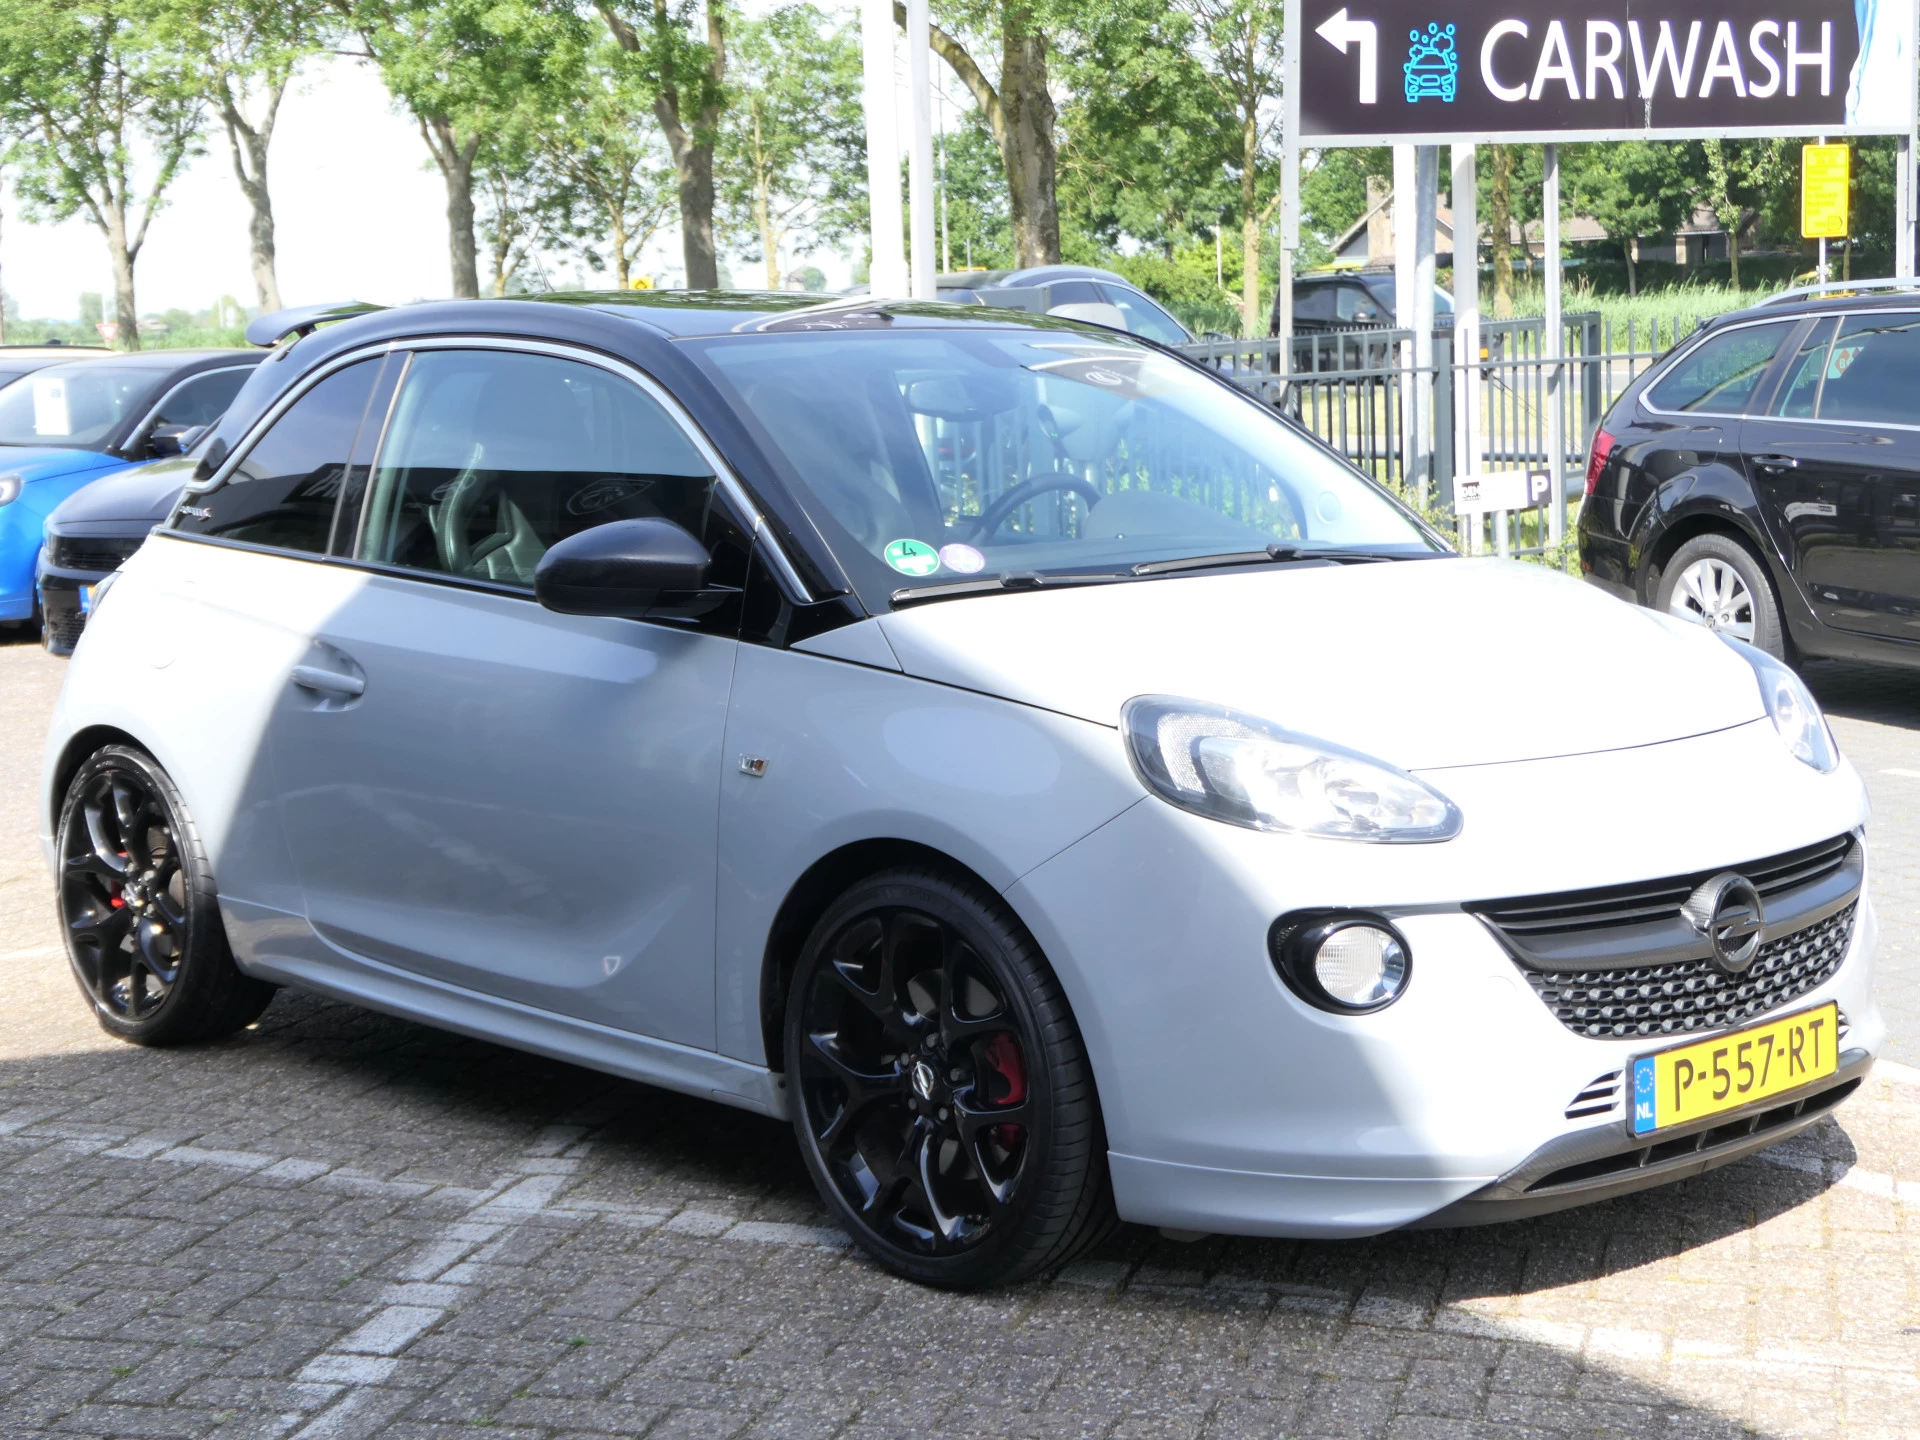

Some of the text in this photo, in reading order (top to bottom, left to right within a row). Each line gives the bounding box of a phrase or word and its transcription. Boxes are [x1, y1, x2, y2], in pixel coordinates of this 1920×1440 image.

[1480, 19, 1832, 101] CARWASH
[1531, 475, 1548, 501] P
[902, 542, 917, 556] 4
[1674, 1018, 1824, 1112] P-557-RT
[1636, 1101, 1653, 1120] NL
